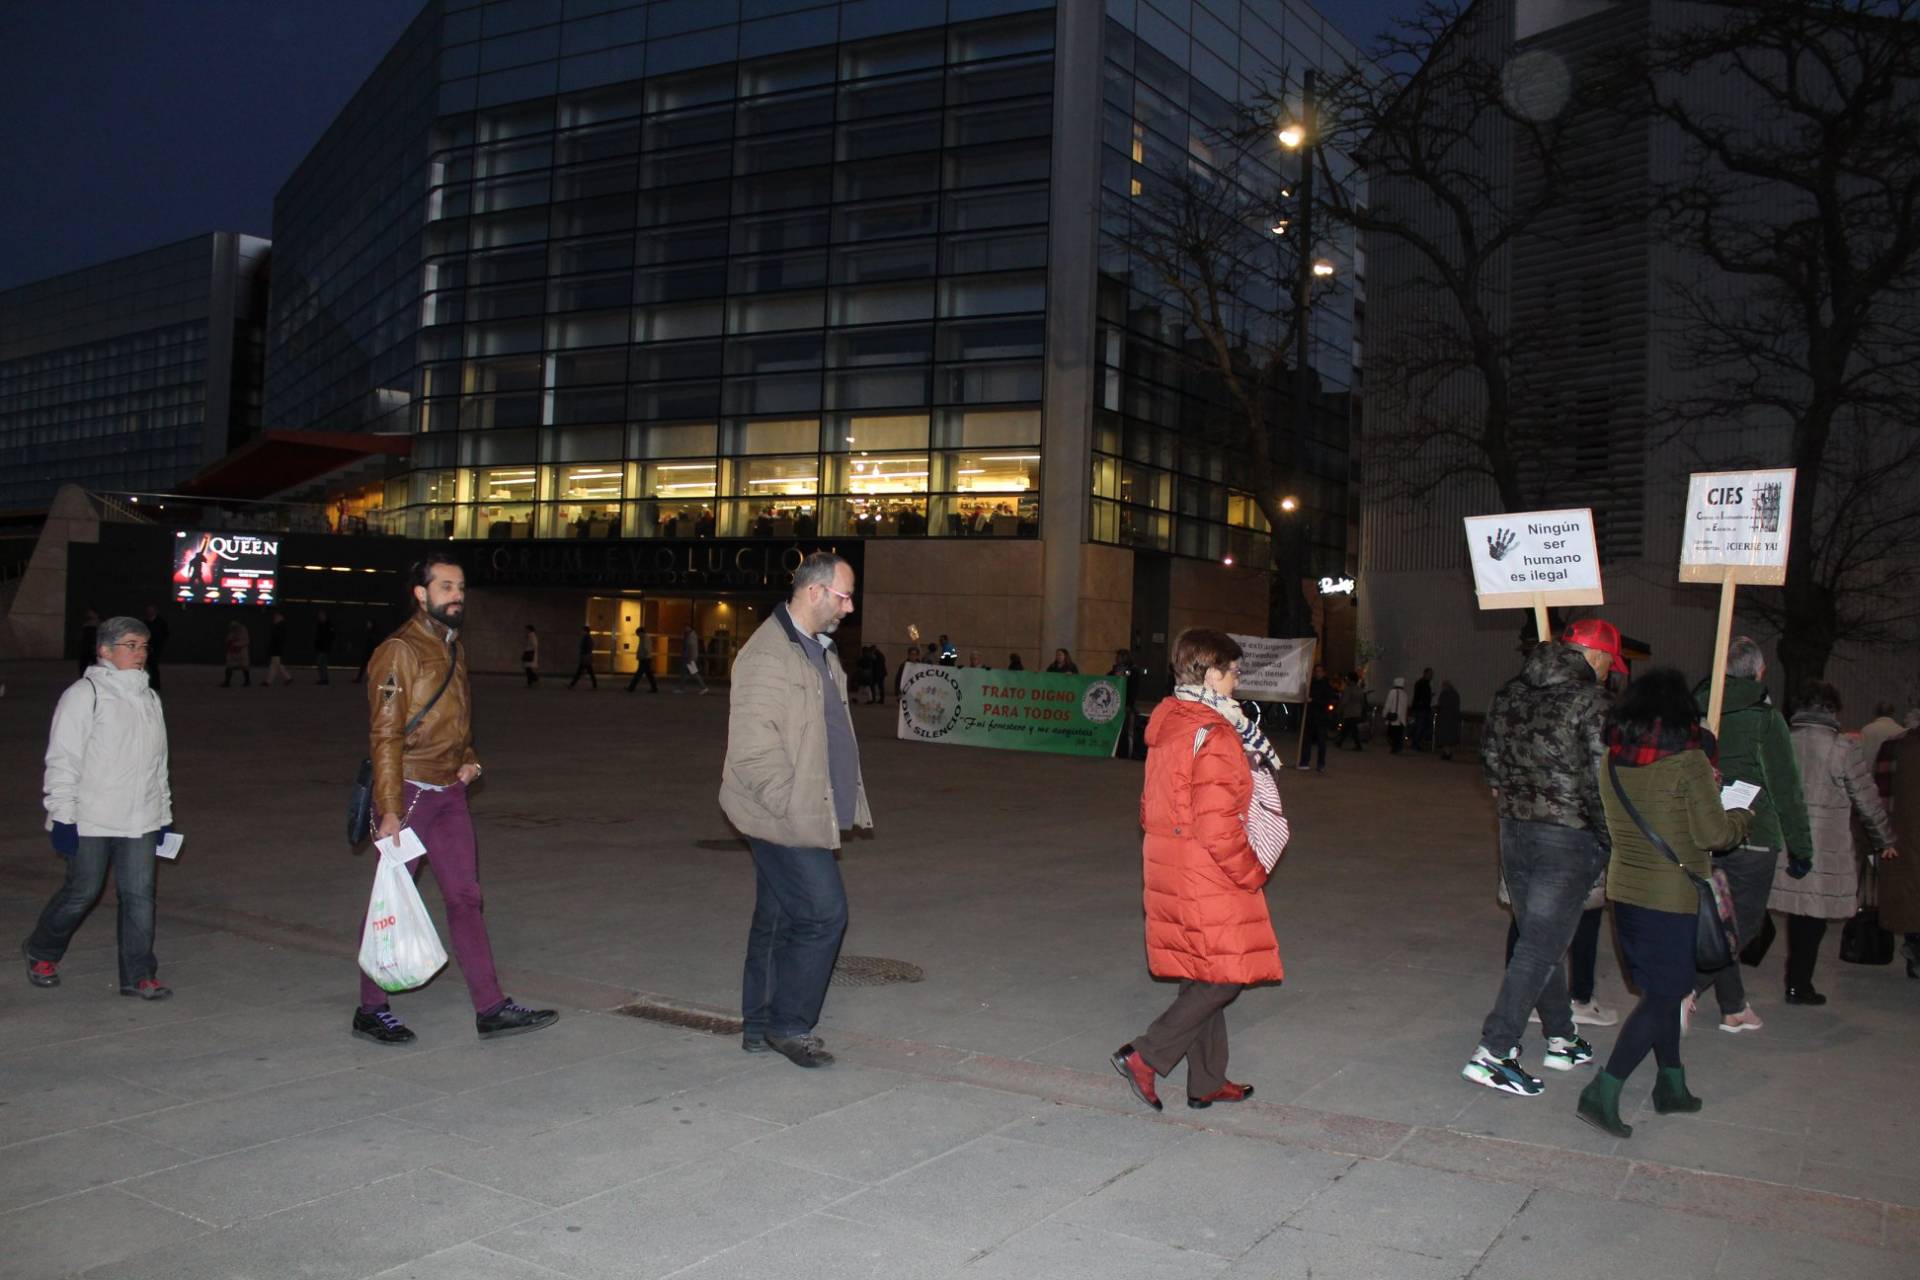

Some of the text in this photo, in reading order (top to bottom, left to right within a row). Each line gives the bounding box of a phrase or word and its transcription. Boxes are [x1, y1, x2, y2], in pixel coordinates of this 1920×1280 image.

[1706, 486, 1744, 506] CIES
[1527, 521, 1580, 536] Ningún
[209, 537, 278, 561] QUEEN
[1543, 539, 1567, 550] ser
[605, 542, 837, 573] EVOLUCIÓ
[1523, 554, 1582, 566] humano
[1510, 568, 1568, 583] es ilegal
[981, 685, 1075, 704] TRATO DIGNO
[983, 703, 1019, 718] PARA
[1023, 706, 1072, 721] TODOS
